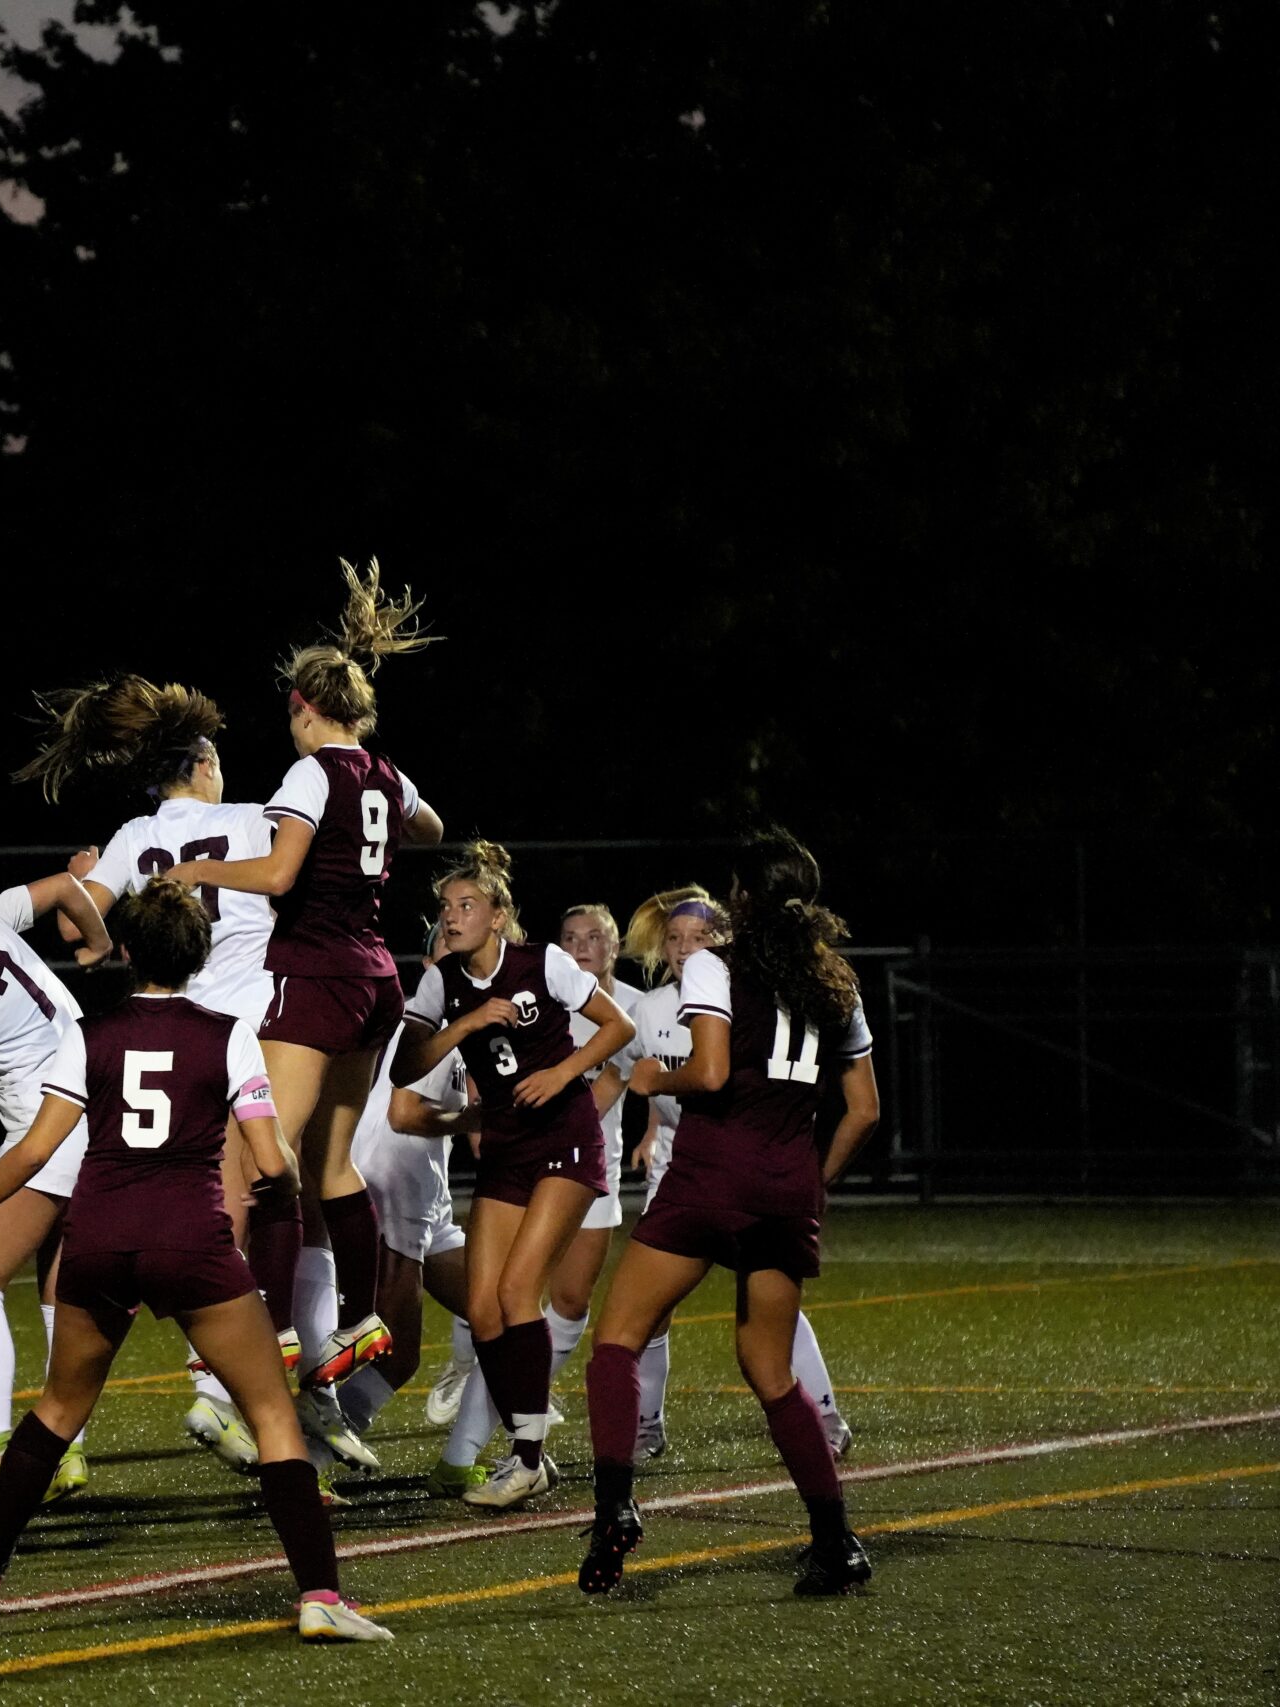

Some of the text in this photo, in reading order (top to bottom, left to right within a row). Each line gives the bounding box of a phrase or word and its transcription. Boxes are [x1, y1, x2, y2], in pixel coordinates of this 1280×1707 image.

[360, 790, 388, 875] 9
[511, 990, 539, 1026] C
[490, 1036, 518, 1076] 3
[767, 1004, 820, 1084] 11
[121, 1050, 174, 1148] 5
[251, 1089, 269, 1100] CAP
